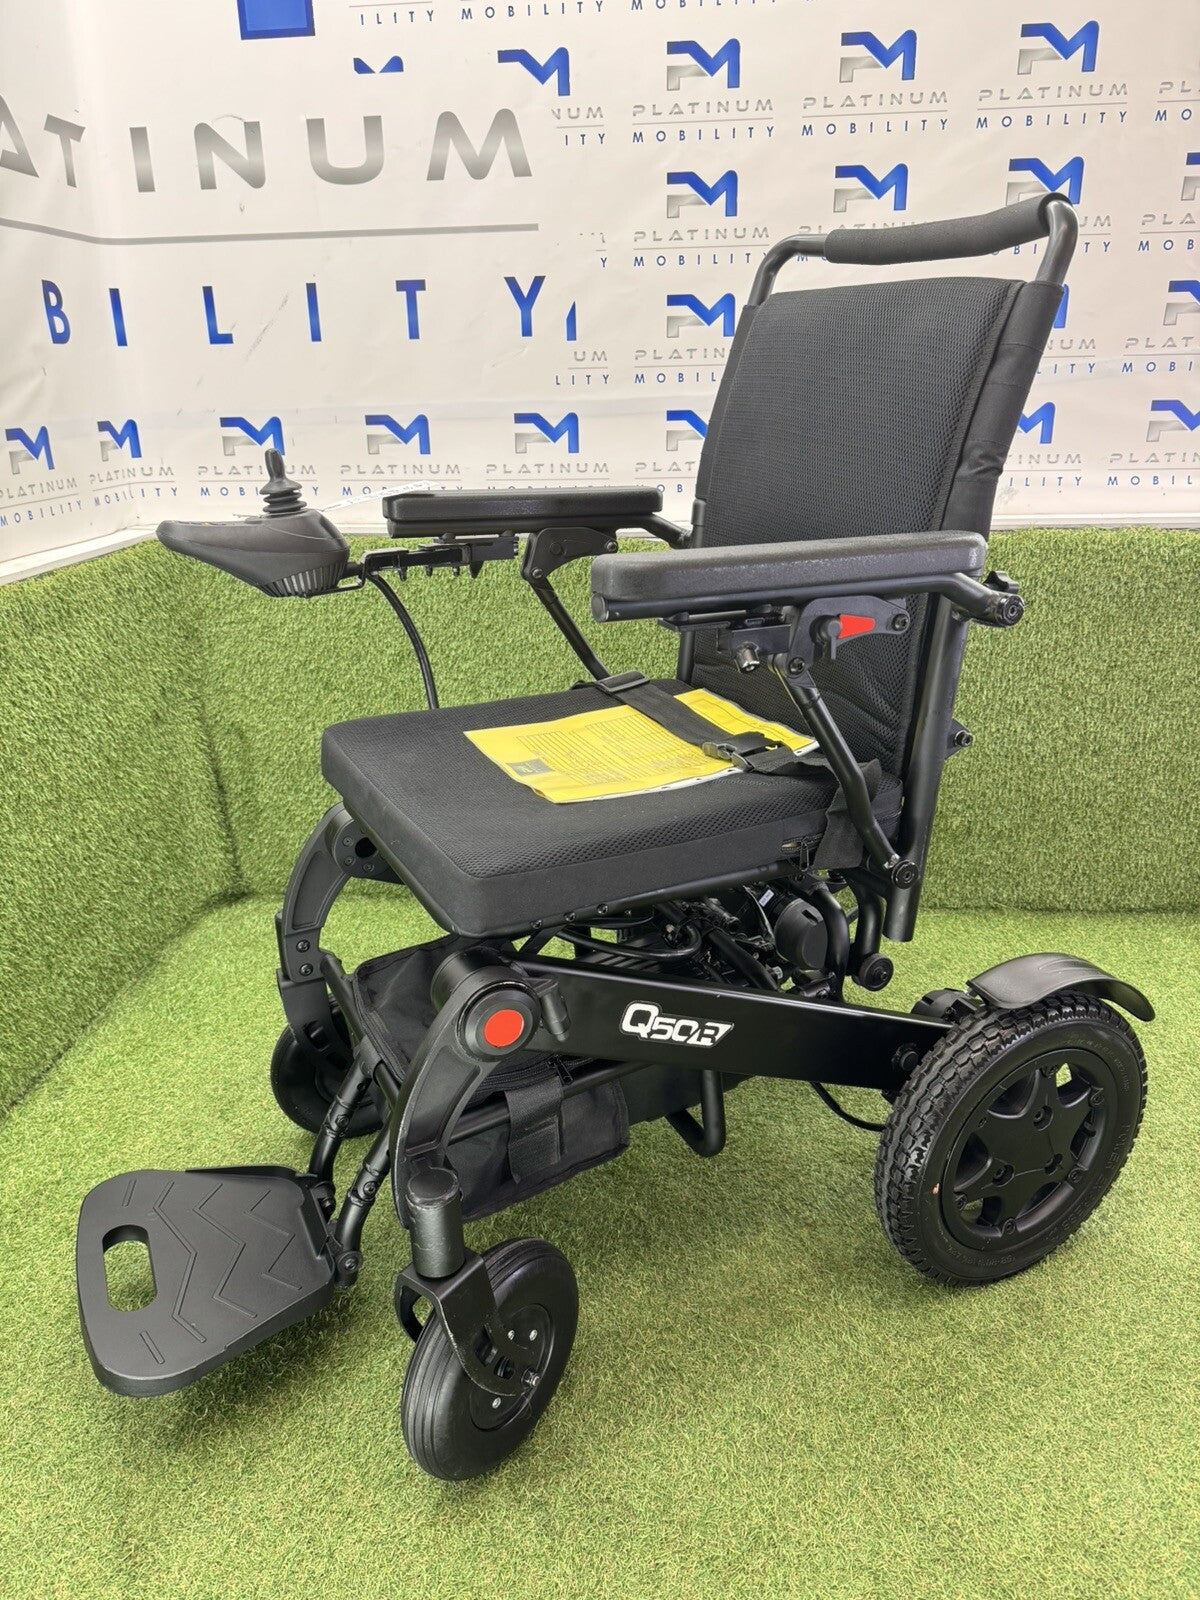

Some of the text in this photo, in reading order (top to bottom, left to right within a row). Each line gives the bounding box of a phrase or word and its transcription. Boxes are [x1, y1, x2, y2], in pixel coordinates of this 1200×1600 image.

[802, 91, 948, 109] PLATINUM
[977, 83, 1128, 102] PLATINUM
[632, 98, 773, 117] PLATINUM
[801, 118, 948, 136] MOBILITY
[976, 111, 1127, 129] MOBILITY
[632, 126, 774, 143] MOBILITY
[633, 226, 770, 242] PLATINUM
[633, 252, 767, 267] MOBILIT
[42, 275, 546, 347] BILITY
[89, 466, 174, 485] PLATINUM
[340, 463, 461, 475] PLATINUM
[486, 462, 609, 474] PLATINUM
[0, 499, 82, 527] MOBILITY
